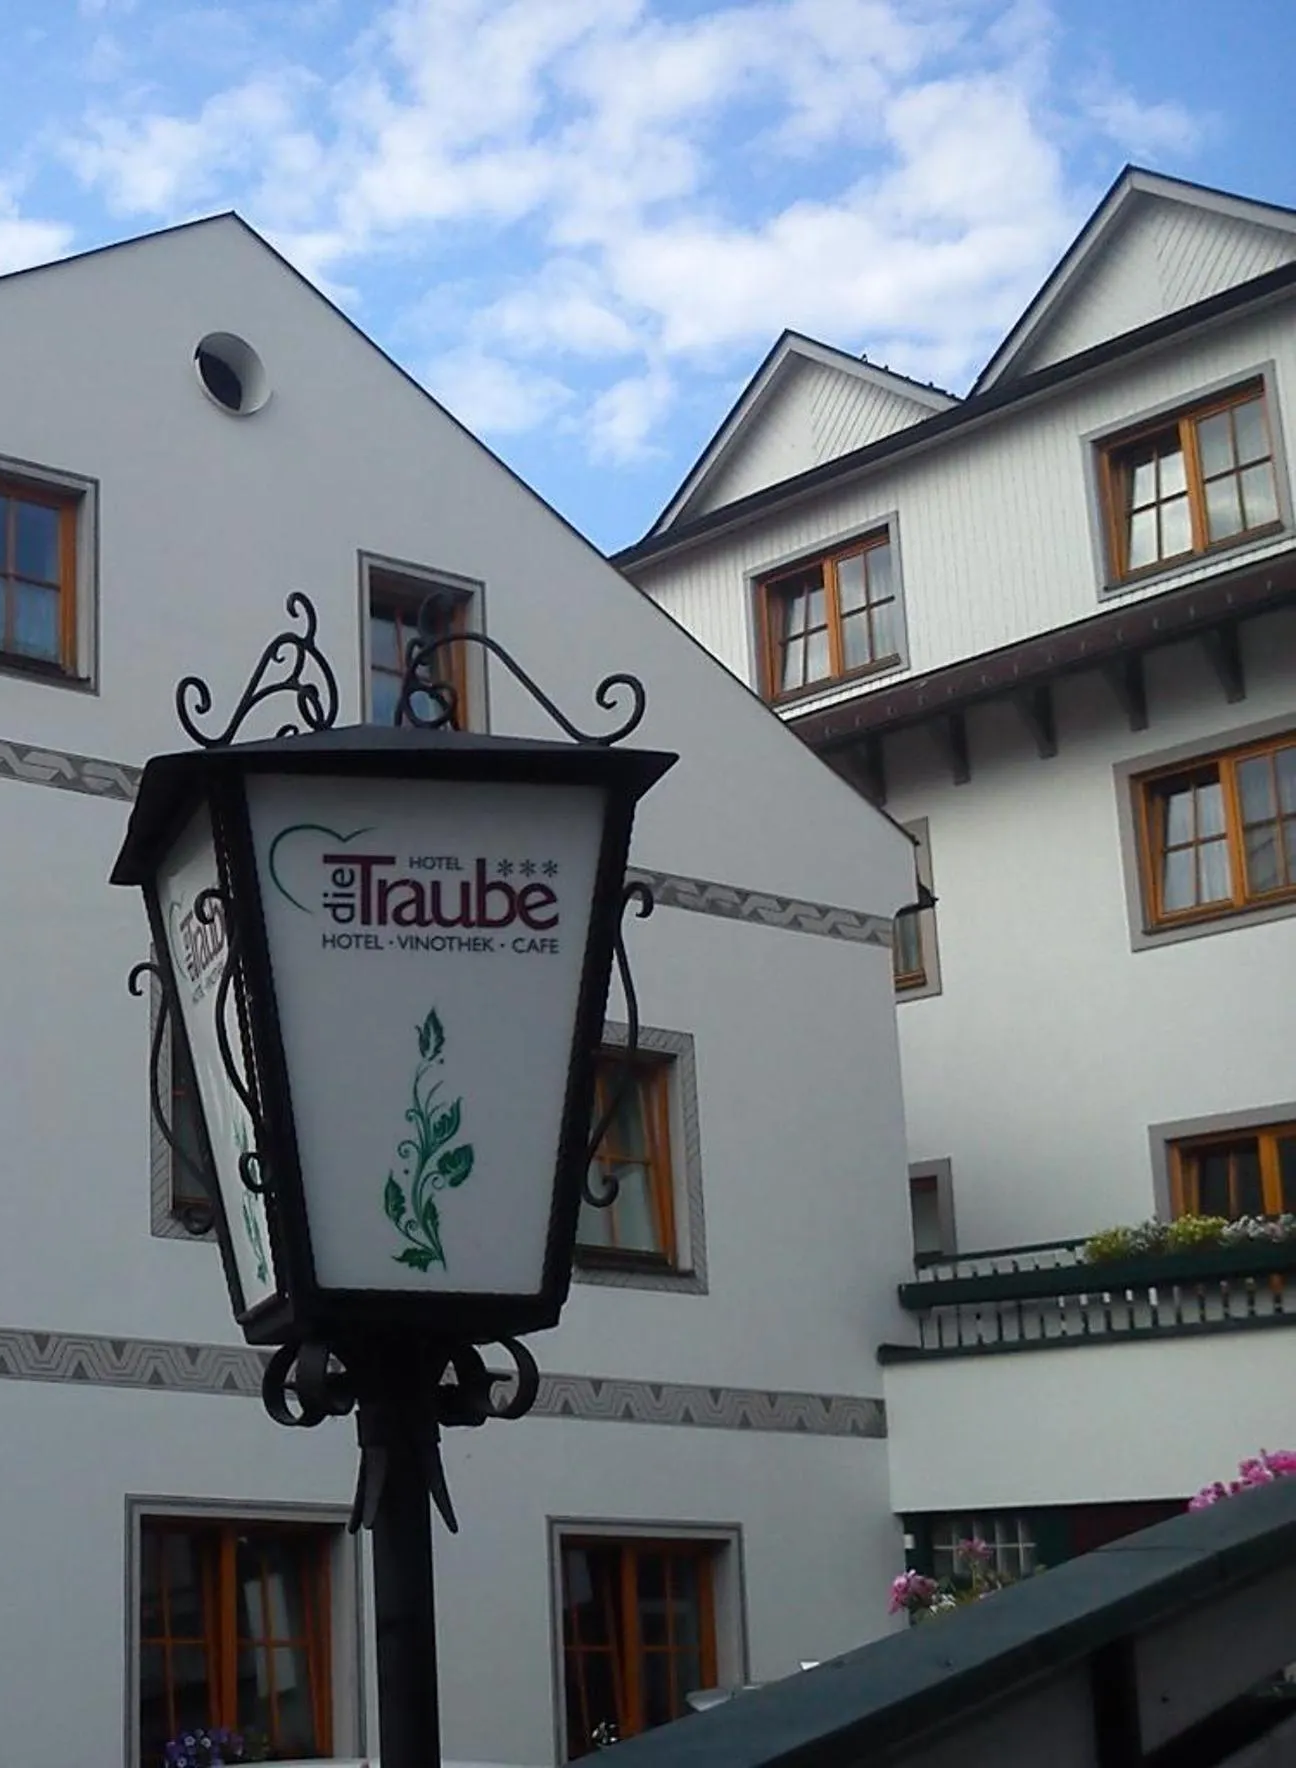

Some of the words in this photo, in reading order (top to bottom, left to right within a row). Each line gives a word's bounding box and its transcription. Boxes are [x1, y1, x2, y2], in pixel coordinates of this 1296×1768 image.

[408, 856, 464, 871] HOTEL
[322, 854, 559, 931] Traube
[323, 866, 355, 924] die
[322, 933, 384, 950] HOTEL
[396, 934, 495, 952] VINOTHEK
[511, 937, 559, 954] CAFE
